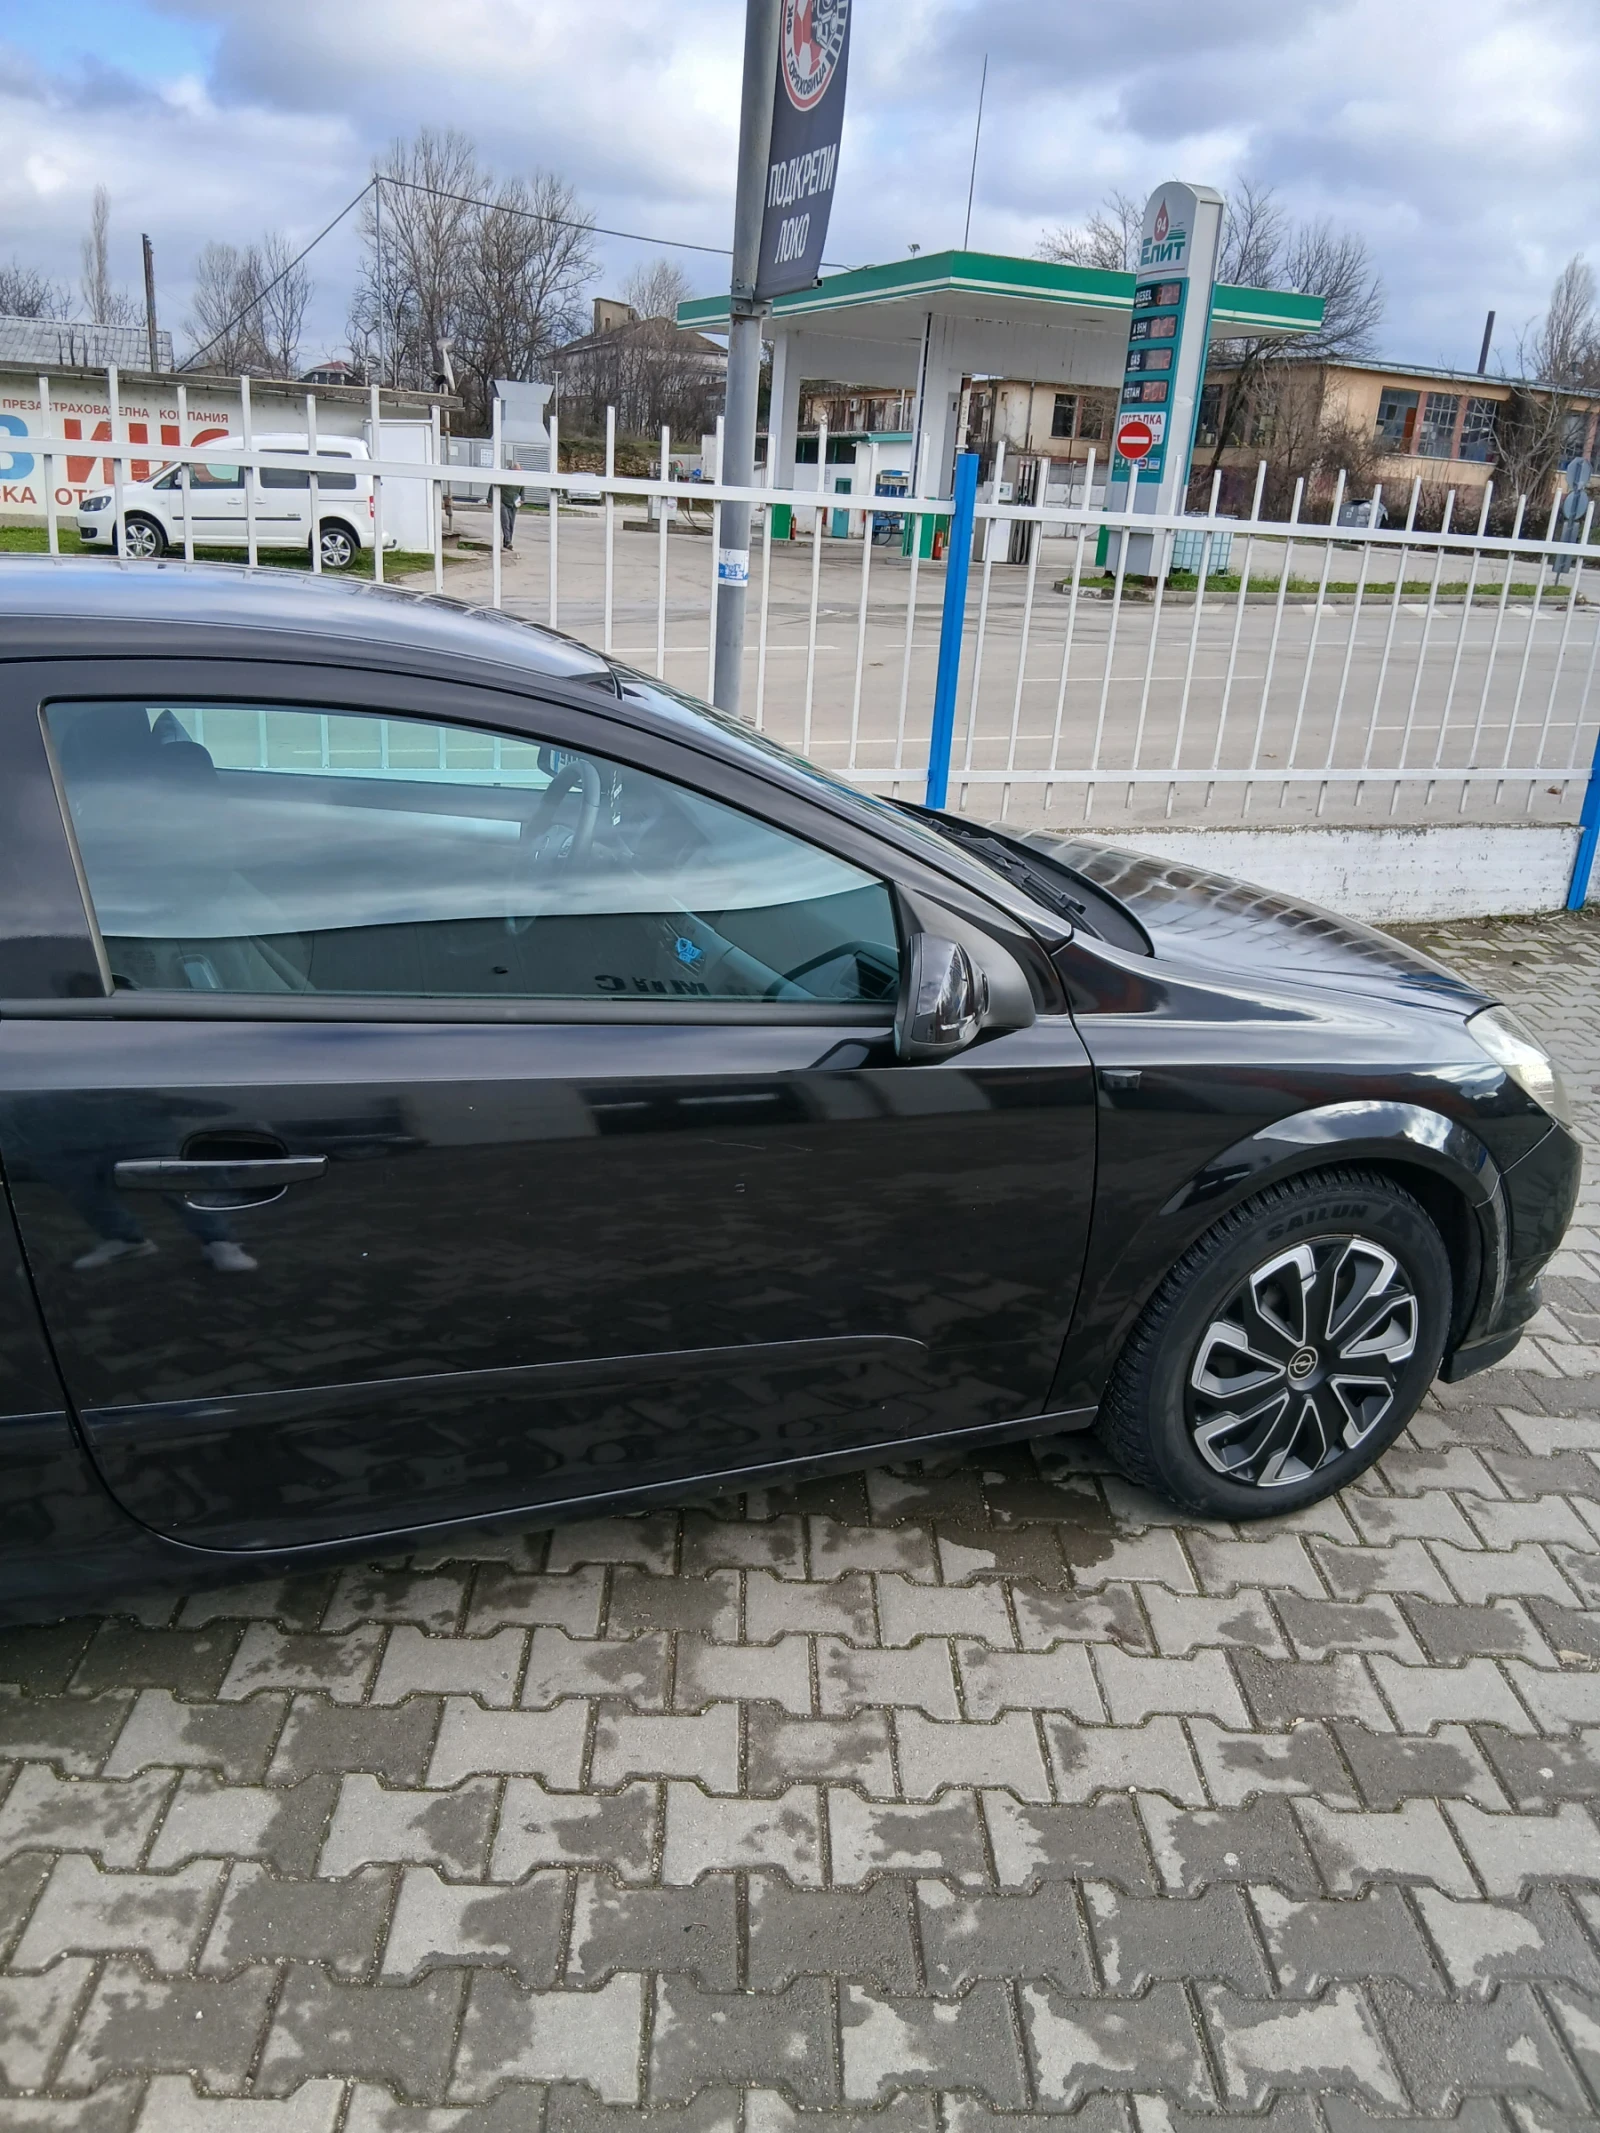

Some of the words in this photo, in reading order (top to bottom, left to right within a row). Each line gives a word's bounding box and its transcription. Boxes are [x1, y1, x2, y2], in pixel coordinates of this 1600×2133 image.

[768, 143, 837, 208] ПОДКРЕПИ
[1157, 216, 1167, 233] 94
[775, 212, 810, 264] ЛОКО
[1131, 354, 1141, 366] GAS
[3, 398, 150, 418] ПРЕЗАТРАХОВАЕЛНА
[159, 409, 229, 423] КОПАНИЯ
[0, 485, 37, 504] КА
[1266, 1204, 1369, 1242] SAILUN
